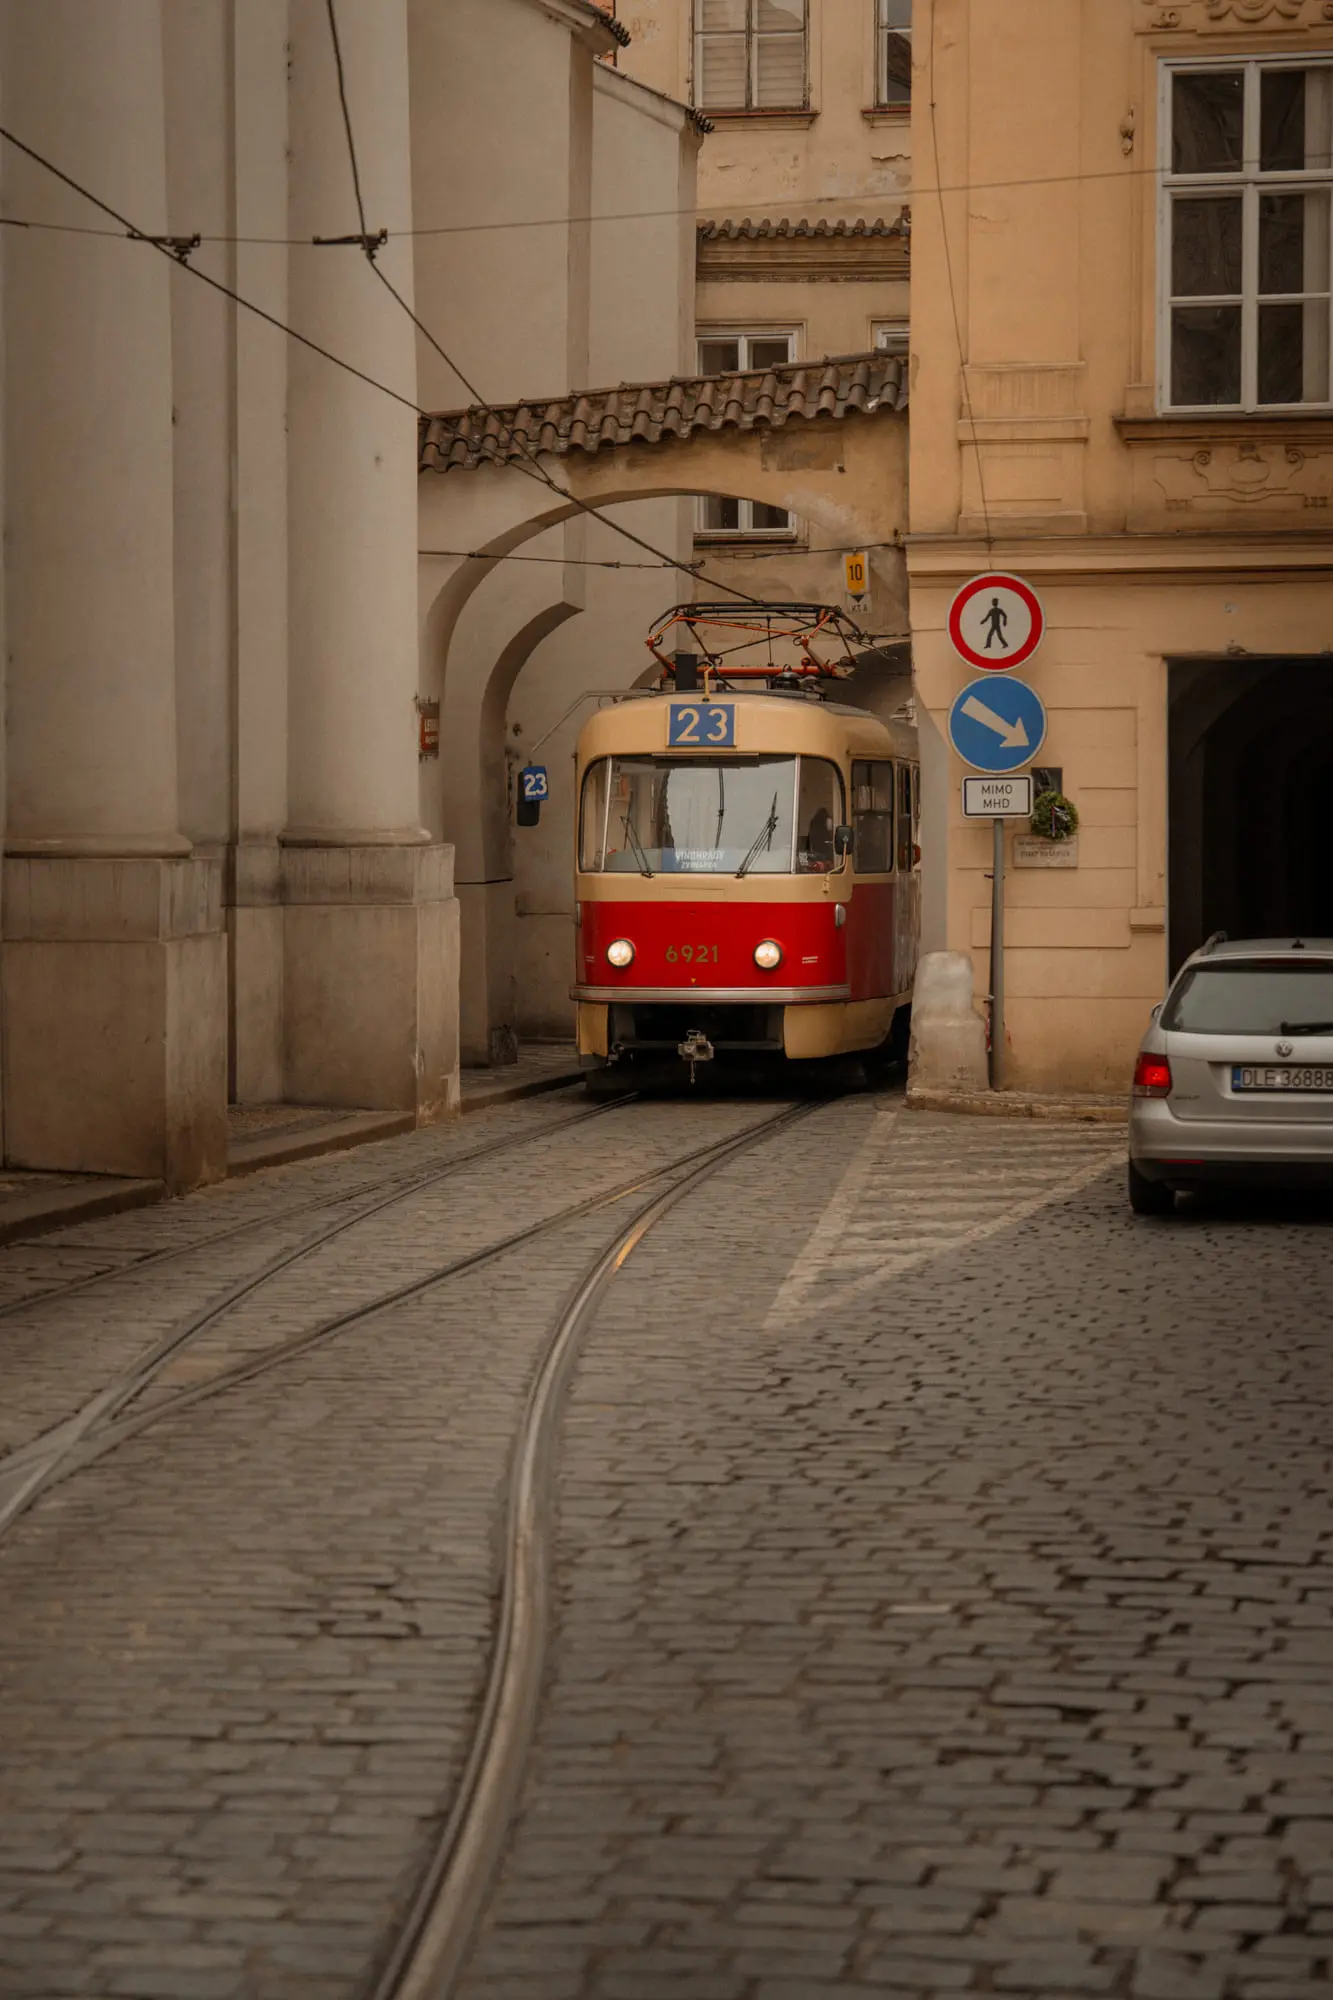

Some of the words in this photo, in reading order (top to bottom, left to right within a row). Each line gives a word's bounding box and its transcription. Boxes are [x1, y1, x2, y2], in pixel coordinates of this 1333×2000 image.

[849, 564, 862, 580] 10
[676, 708, 728, 742] 23
[524, 773, 547, 796] 23
[981, 784, 1013, 795] MIMO
[983, 798, 1010, 809] MHD
[665, 944, 719, 963] 6921
[1242, 1069, 1275, 1087] DLE
[1281, 1069, 1333, 1088] 36888
